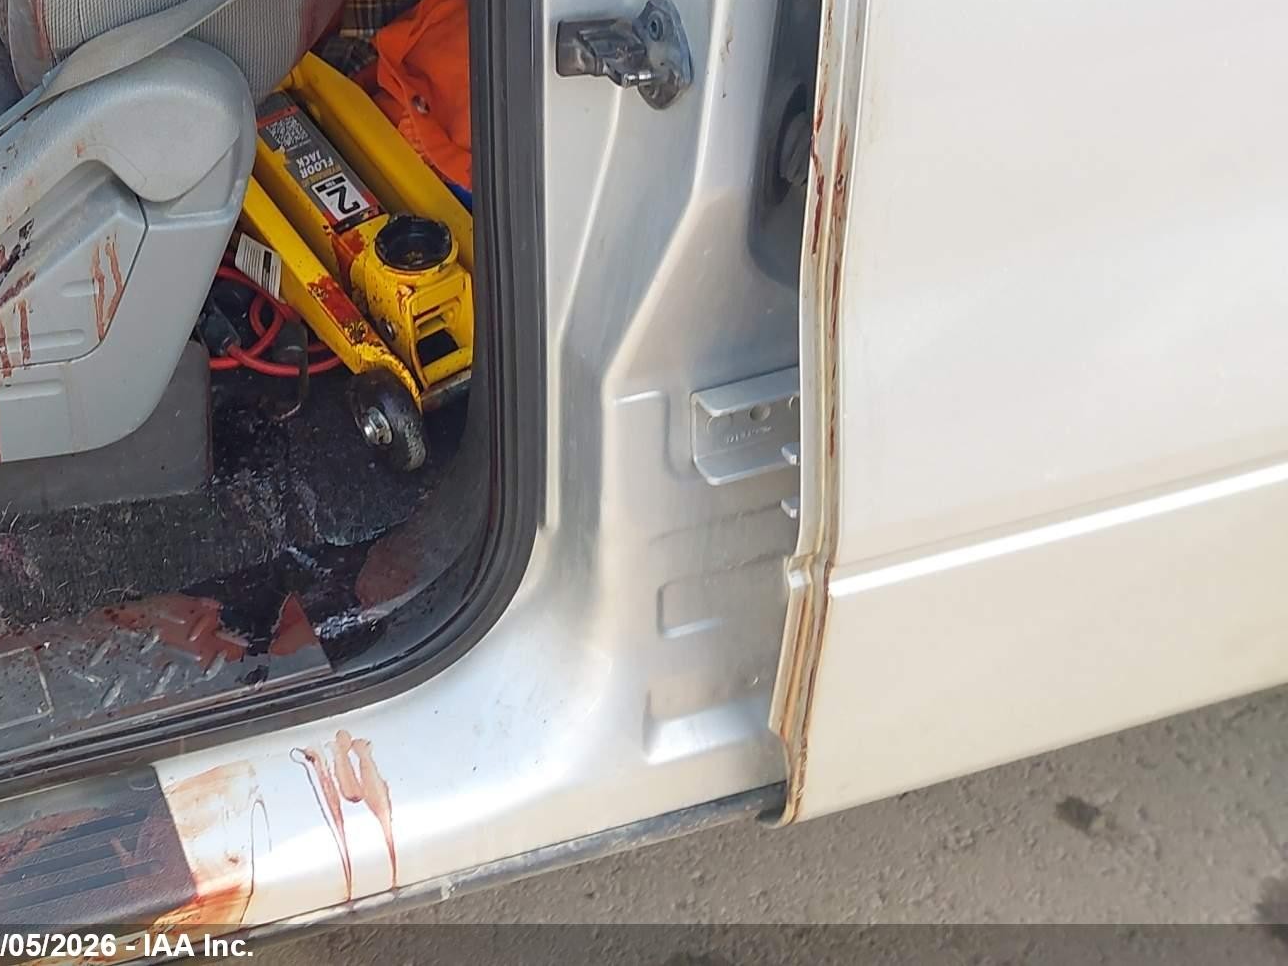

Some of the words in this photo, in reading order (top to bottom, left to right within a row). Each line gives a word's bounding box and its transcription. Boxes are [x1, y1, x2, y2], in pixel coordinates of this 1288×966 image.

[296, 150, 321, 169] JACK
[300, 156, 334, 179] FLOOR
[325, 185, 361, 215] 2
